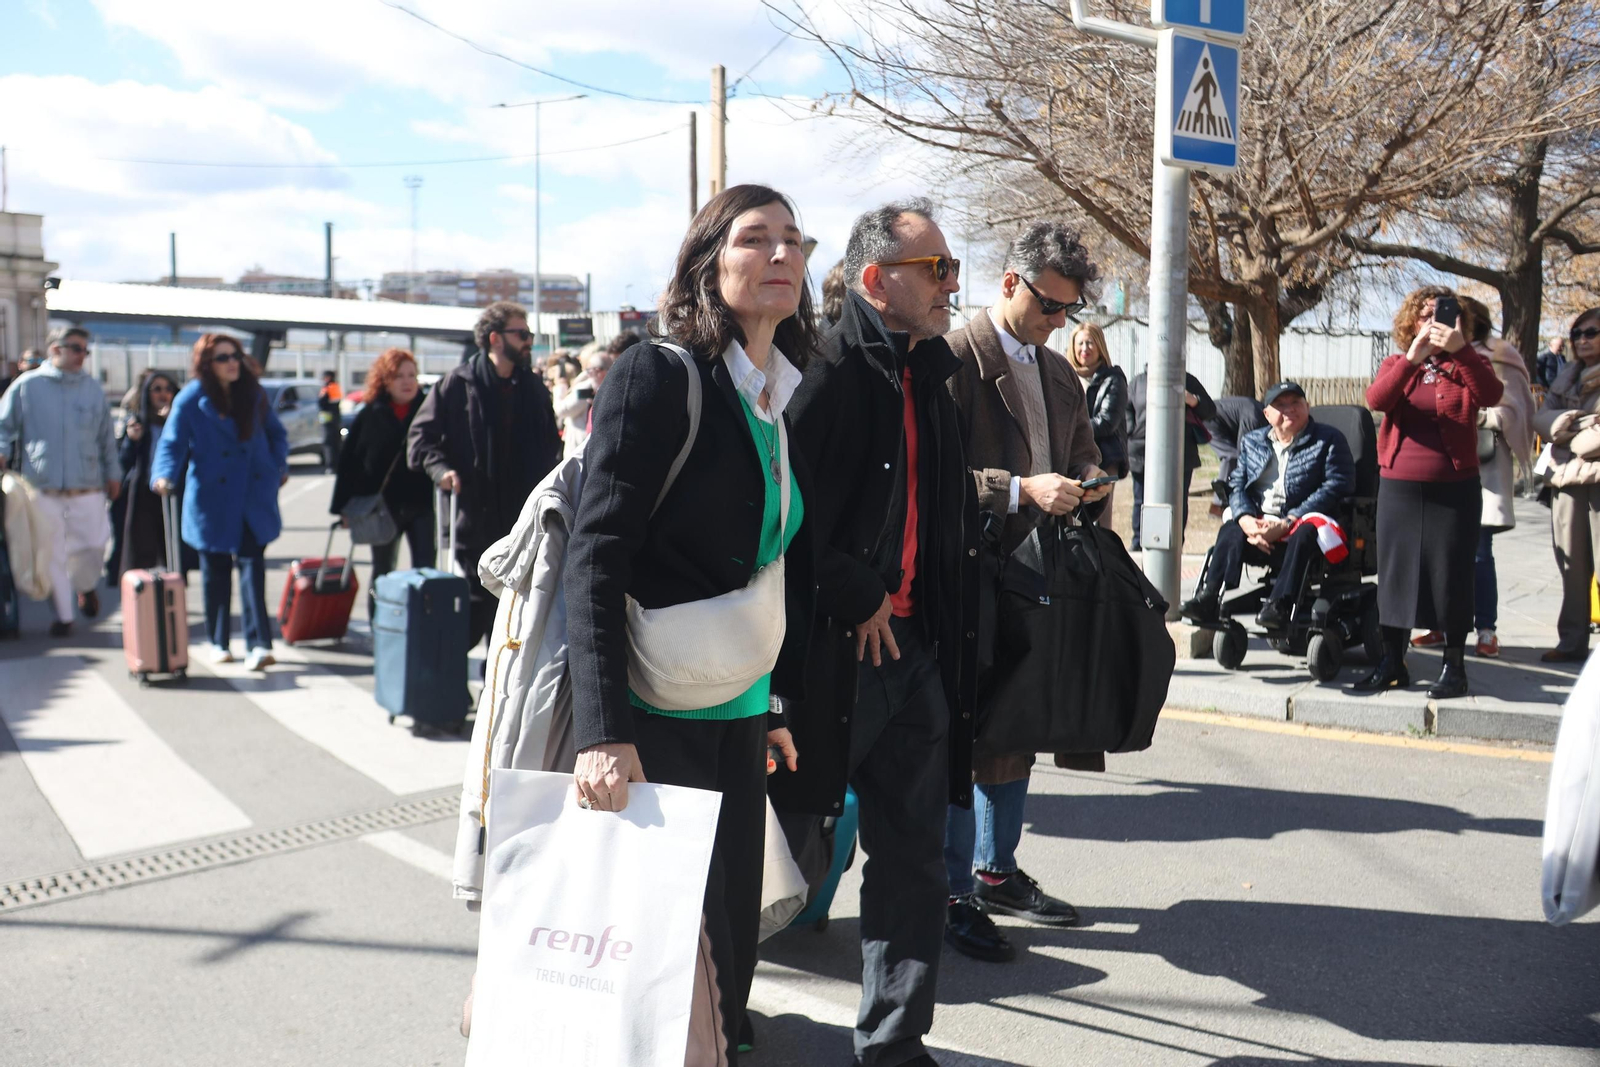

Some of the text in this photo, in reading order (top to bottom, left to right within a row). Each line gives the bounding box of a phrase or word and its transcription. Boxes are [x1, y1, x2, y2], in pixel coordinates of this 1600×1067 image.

[528, 925, 633, 968] renfe
[536, 967, 616, 994] TREN OFICIAL
